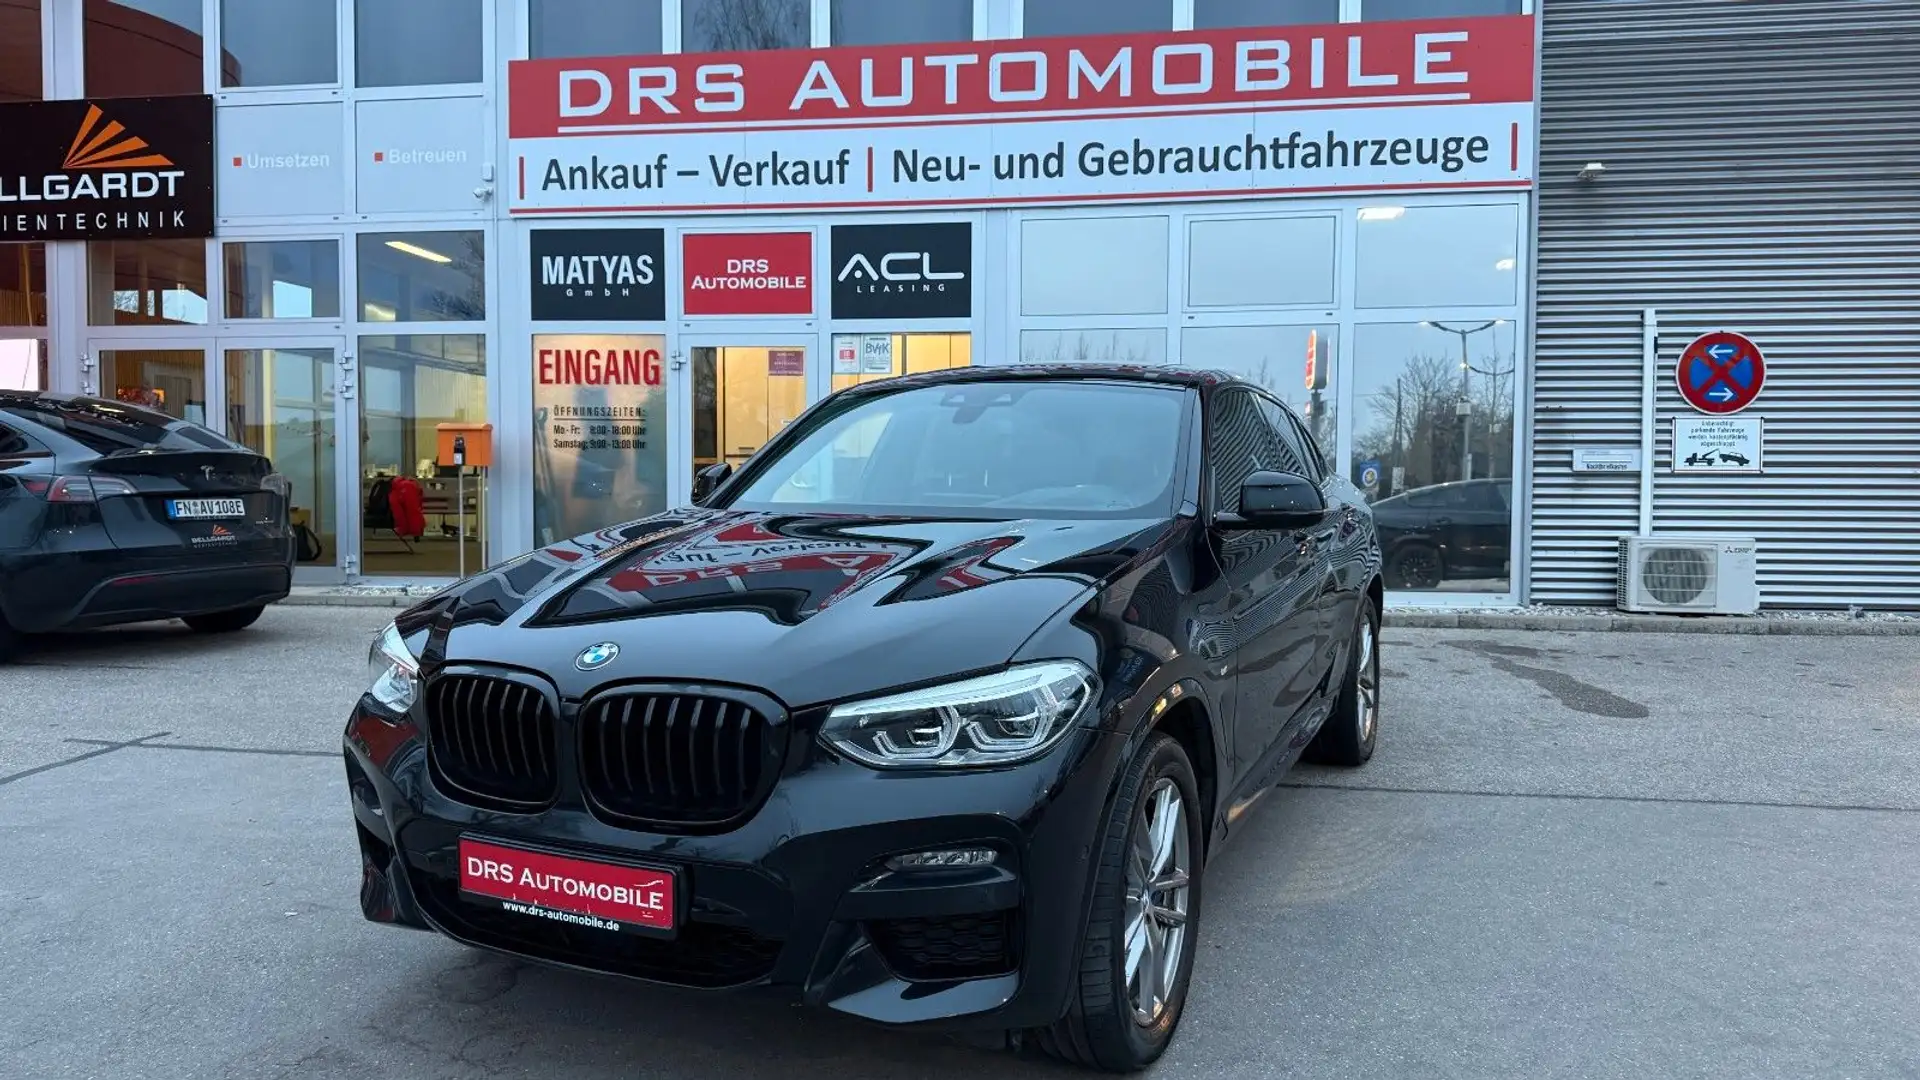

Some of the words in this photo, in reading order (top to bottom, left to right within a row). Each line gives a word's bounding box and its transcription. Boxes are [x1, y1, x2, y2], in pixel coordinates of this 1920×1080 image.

[559, 63, 745, 118] DRS
[789, 31, 1469, 110] AUTOMOBILE
[247, 153, 330, 168] Umsetzen
[389, 149, 467, 164] Betreuen
[541, 153, 668, 191] Ankauf
[708, 148, 851, 188] Verkauf
[893, 148, 981, 183] Neu-
[994, 141, 1065, 180] und
[1077, 131, 1490, 177] Gebrauchtfahrzeuge
[542, 255, 654, 285] MATYAS
[726, 259, 769, 274] DRS
[837, 251, 965, 282] ACL
[691, 275, 806, 290] AUTOMOBILE
[856, 283, 945, 293] LEASING
[566, 288, 629, 296] GmbH
[539, 349, 660, 385] EINGANG
[553, 405, 646, 417] ÖFFNUNGSZEITEN:
[553, 425, 565, 435] Mo
[632, 425, 646, 435] Uhr
[553, 439, 588, 451] Samstag:
[632, 439, 646, 449] Uhr
[176, 501, 191, 515] FN
[467, 857, 513, 883] DRS
[519, 867, 664, 911] AUTOMOBILE
[502, 900, 620, 931] www.drs-automobile.de
